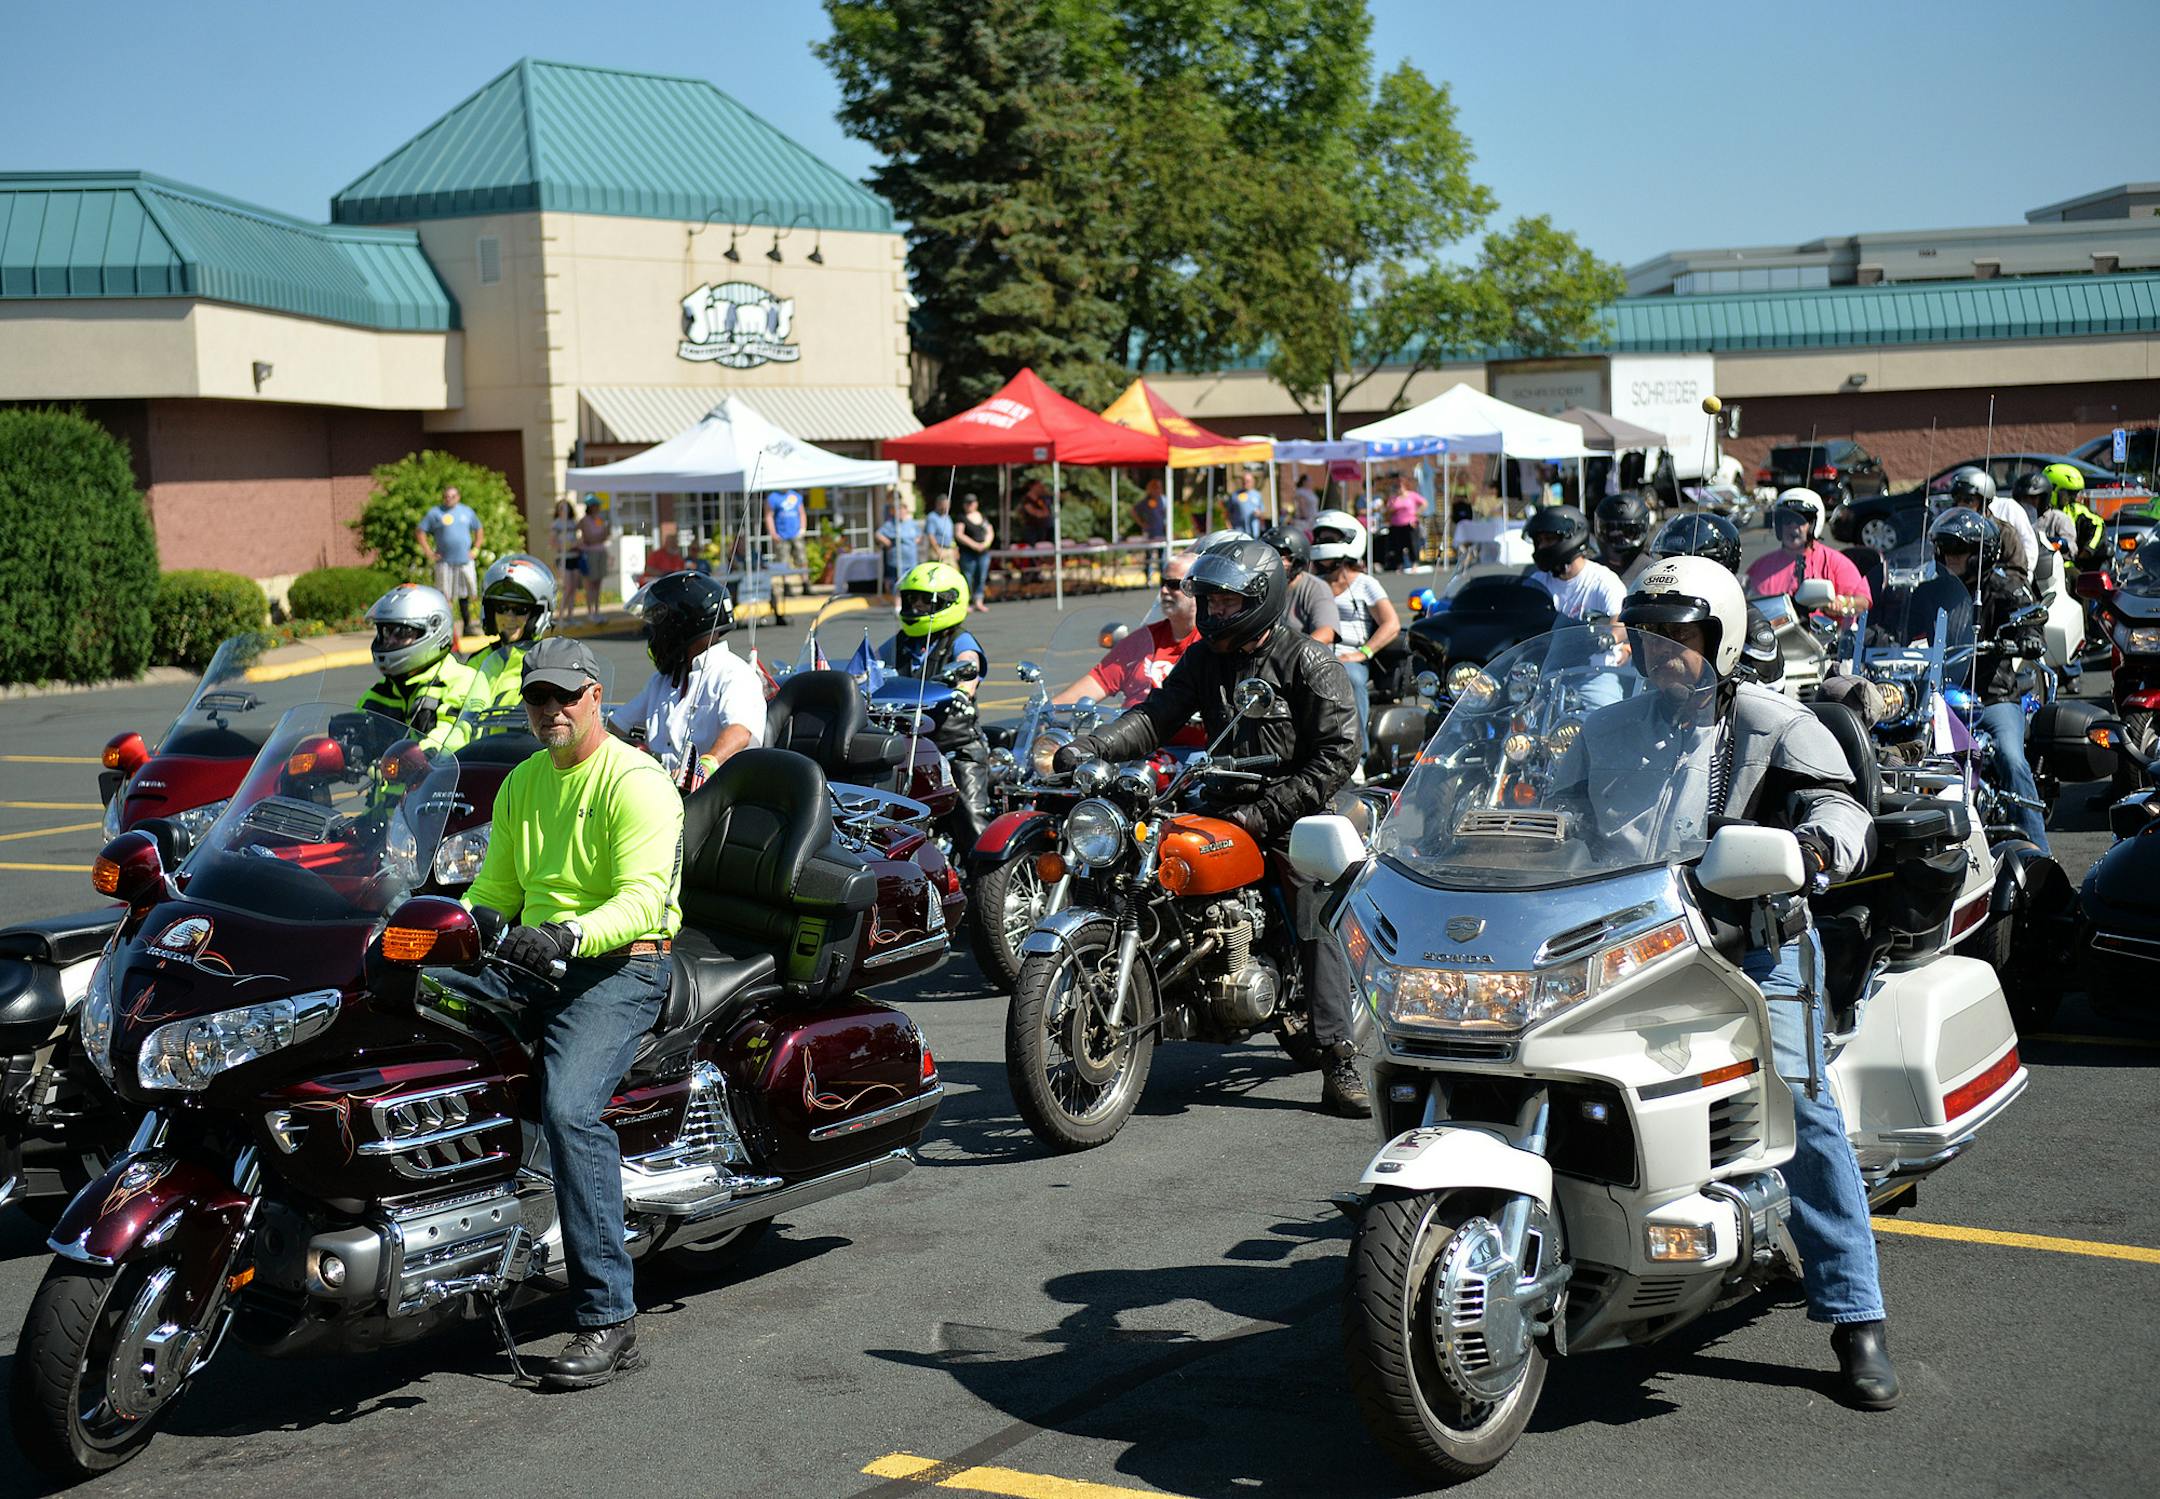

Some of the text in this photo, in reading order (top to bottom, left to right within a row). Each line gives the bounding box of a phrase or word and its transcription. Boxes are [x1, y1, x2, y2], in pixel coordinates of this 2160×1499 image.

[1648, 576, 1675, 584] SHOEI
[1199, 839, 1235, 855] HONDA
[1423, 951, 1497, 964] HONDA
